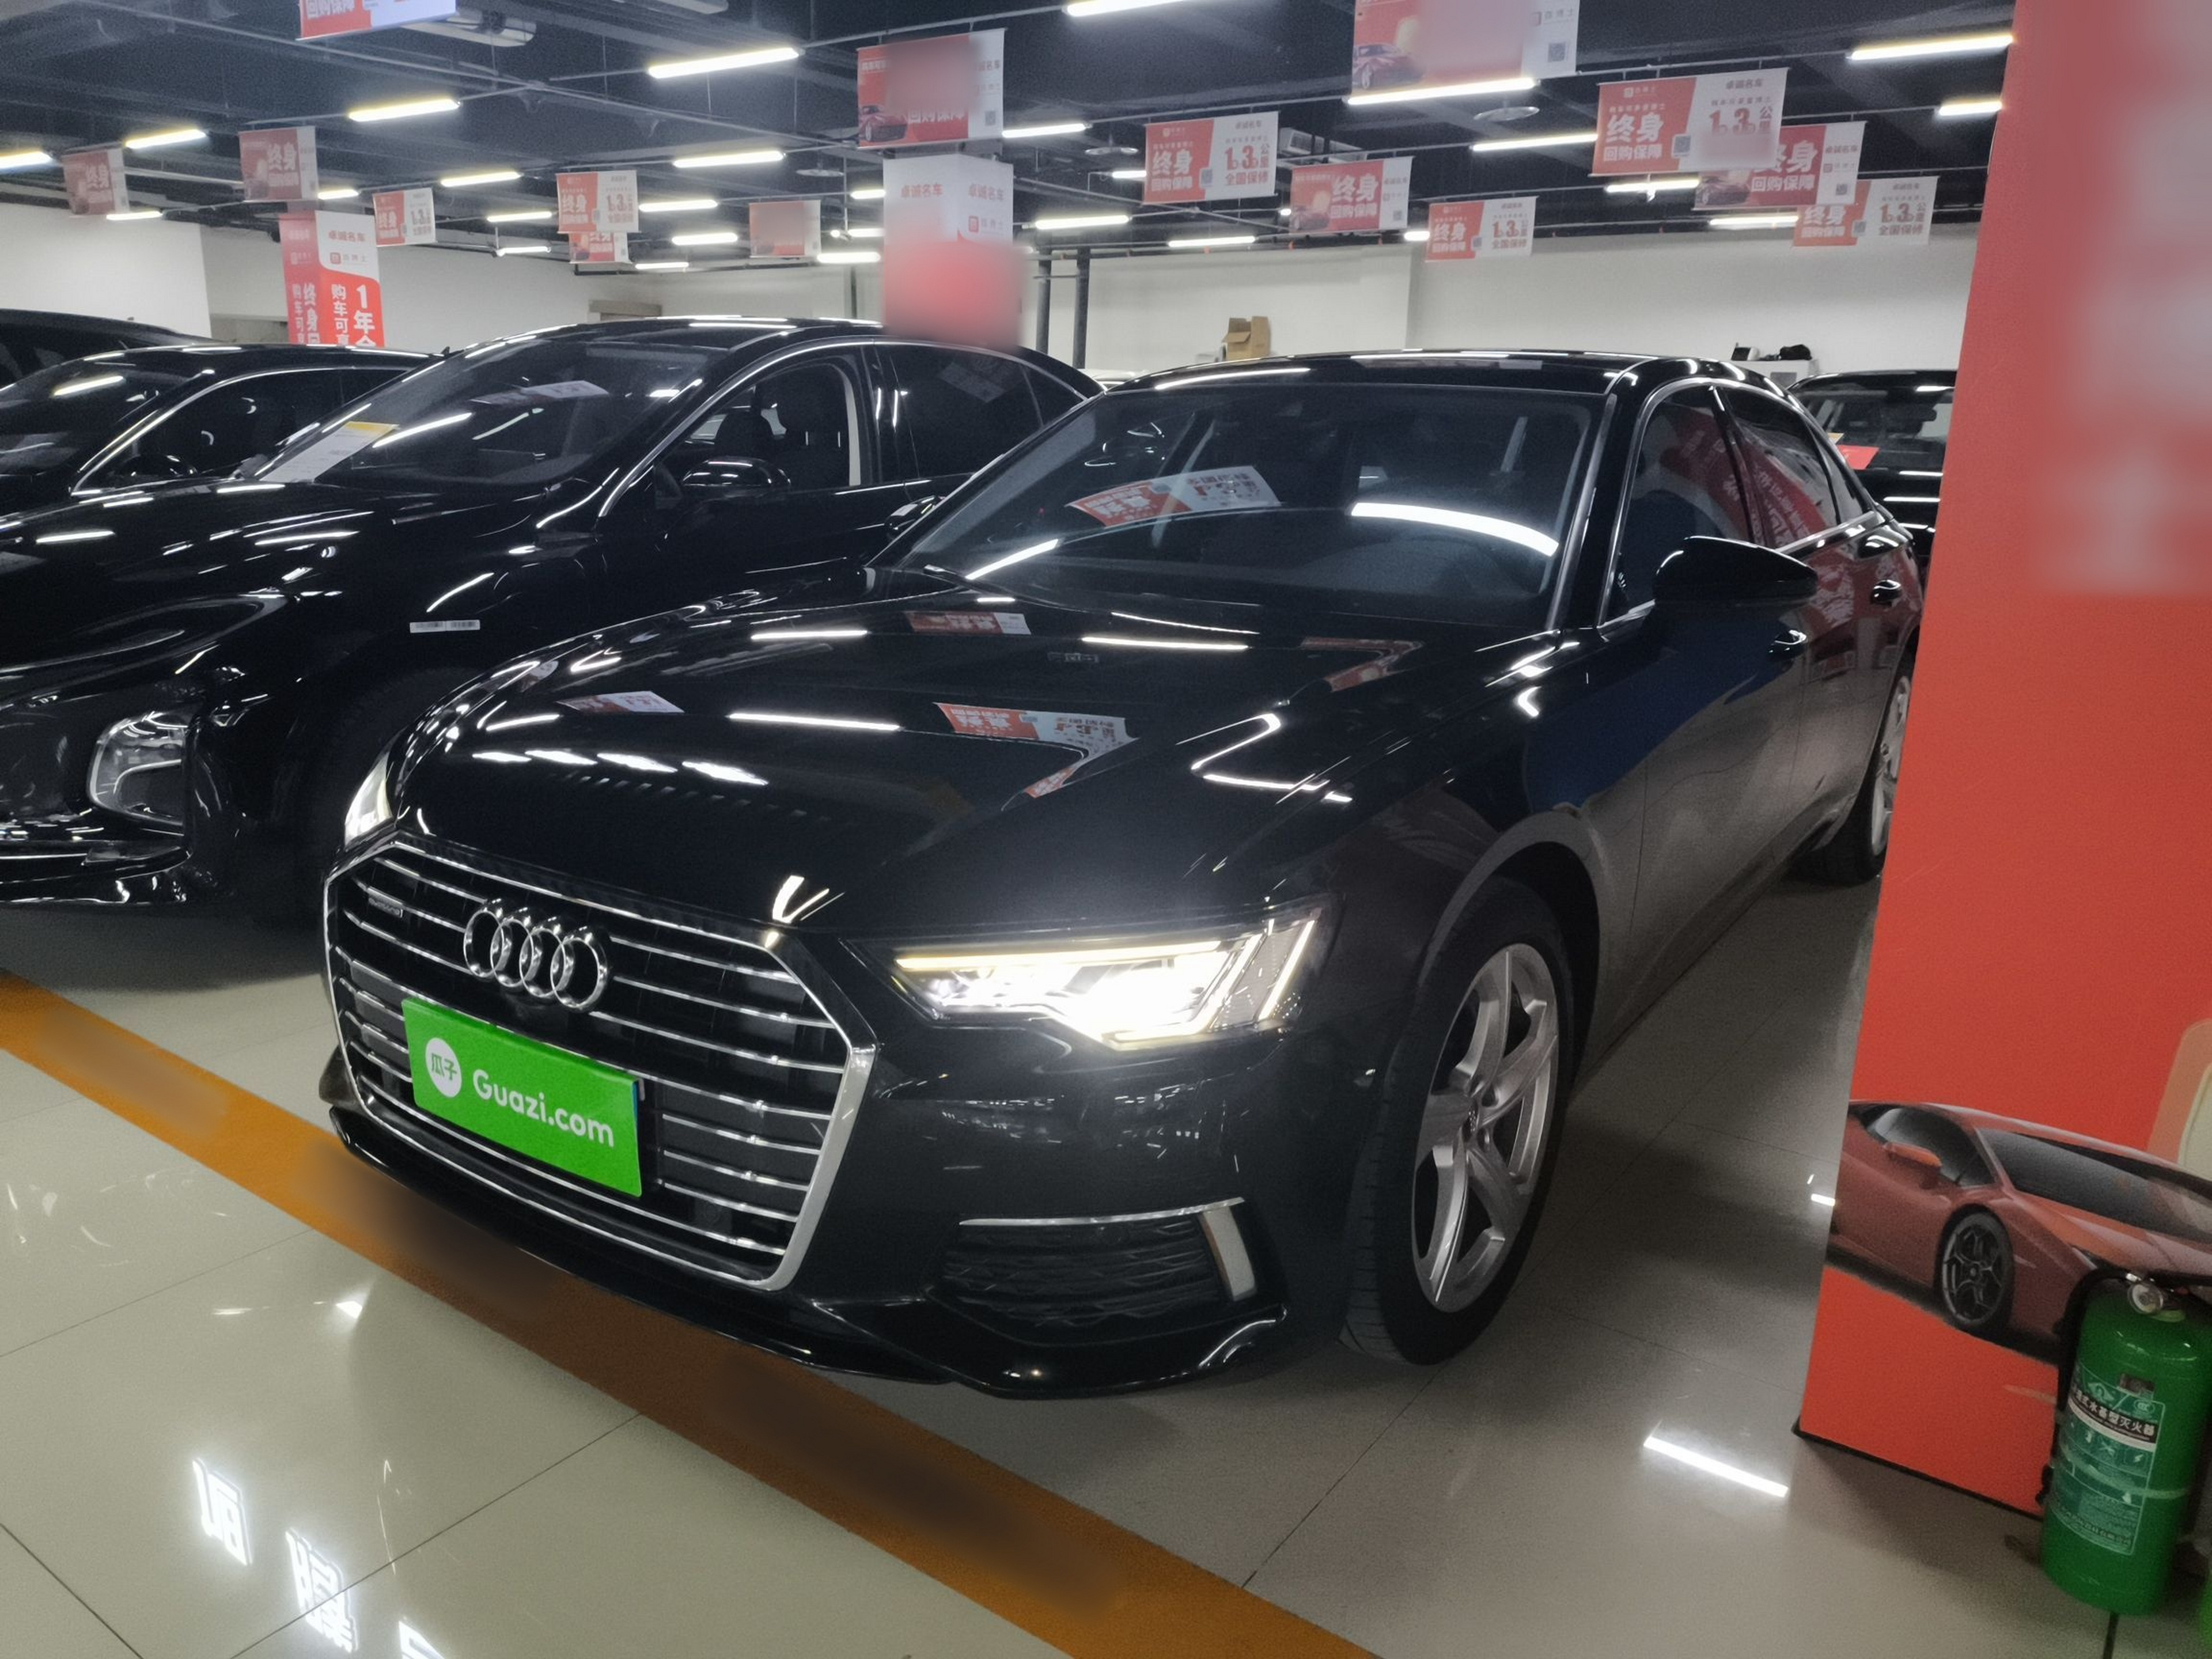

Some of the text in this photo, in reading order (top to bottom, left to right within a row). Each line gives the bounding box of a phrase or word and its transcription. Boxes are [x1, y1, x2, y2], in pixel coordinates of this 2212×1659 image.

[1606, 112, 1665, 143] 终身
[267, 142, 297, 171] 终身
[1153, 148, 1193, 176] 终身
[1603, 144, 1662, 162] 回购保障
[1331, 173, 1379, 202] 终身
[1750, 174, 1816, 192] 回购保障
[1434, 221, 1467, 241] 终身
[431, 1053, 457, 1081] 瓜子
[472, 1069, 615, 1147] Guazi.com
